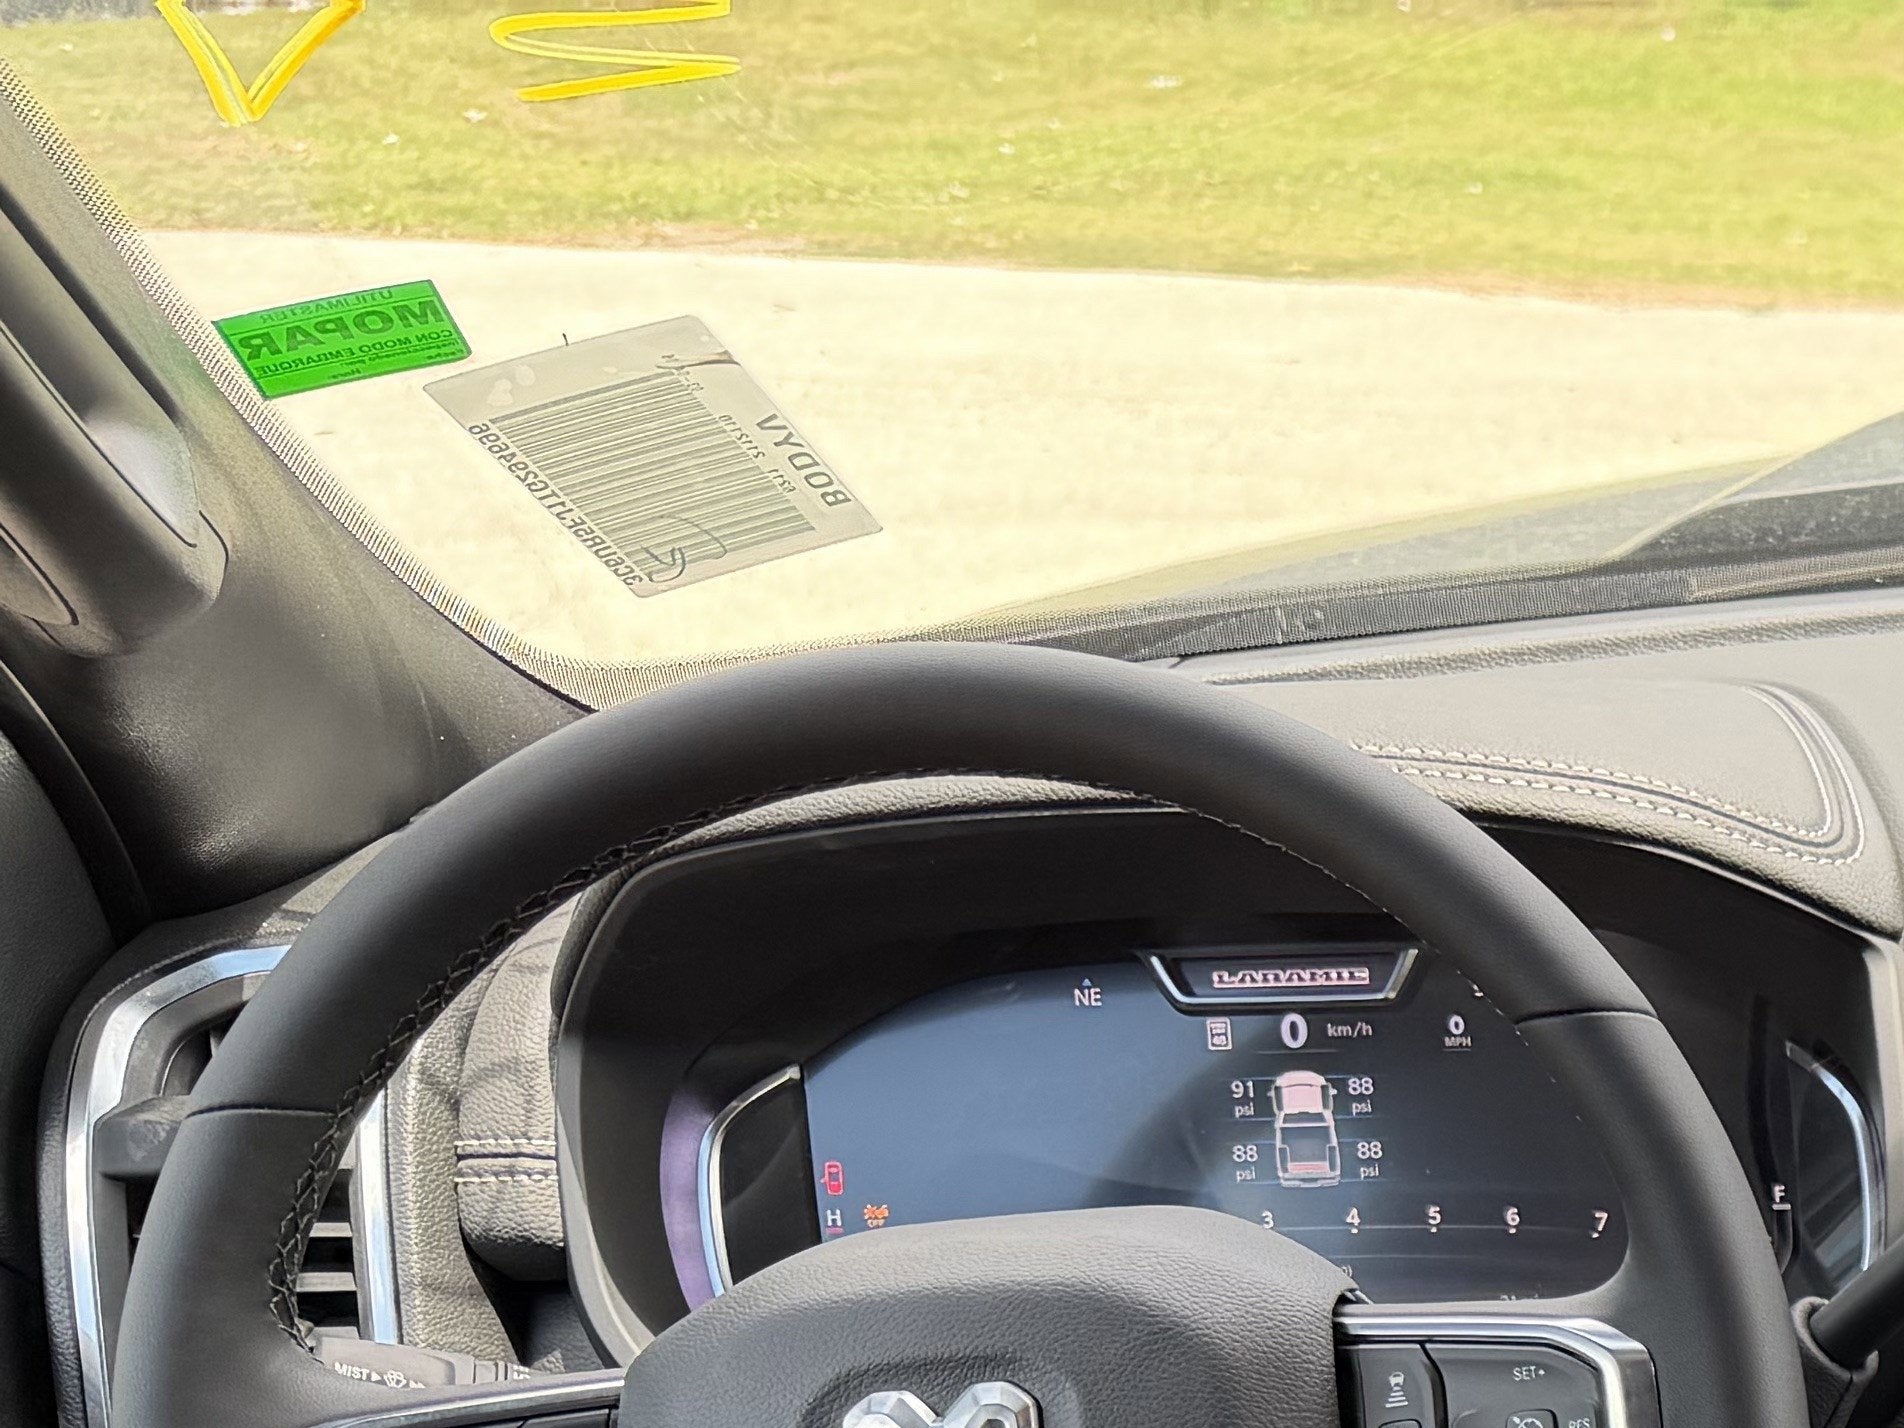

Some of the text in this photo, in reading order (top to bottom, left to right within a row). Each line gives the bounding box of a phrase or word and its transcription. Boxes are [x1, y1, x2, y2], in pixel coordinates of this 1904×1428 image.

[1212, 967, 1370, 989] LARAMIE
[1073, 987, 1103, 1007] NE
[1280, 1012, 1373, 1049] 0 km/h
[1447, 1014, 1466, 1035] 0
[1443, 1035, 1472, 1047] MPH
[1230, 1077, 1374, 1098] 91 88
[1234, 1099, 1372, 1118] psi psi
[1232, 1141, 1383, 1162] 88 88
[1235, 1163, 1380, 1183] psi psi
[1774, 1184, 1786, 1203] F
[826, 1209, 841, 1227] H
[1260, 1204, 1609, 1232] 3 4 5 6 7
[334, 1361, 370, 1381] MIST
